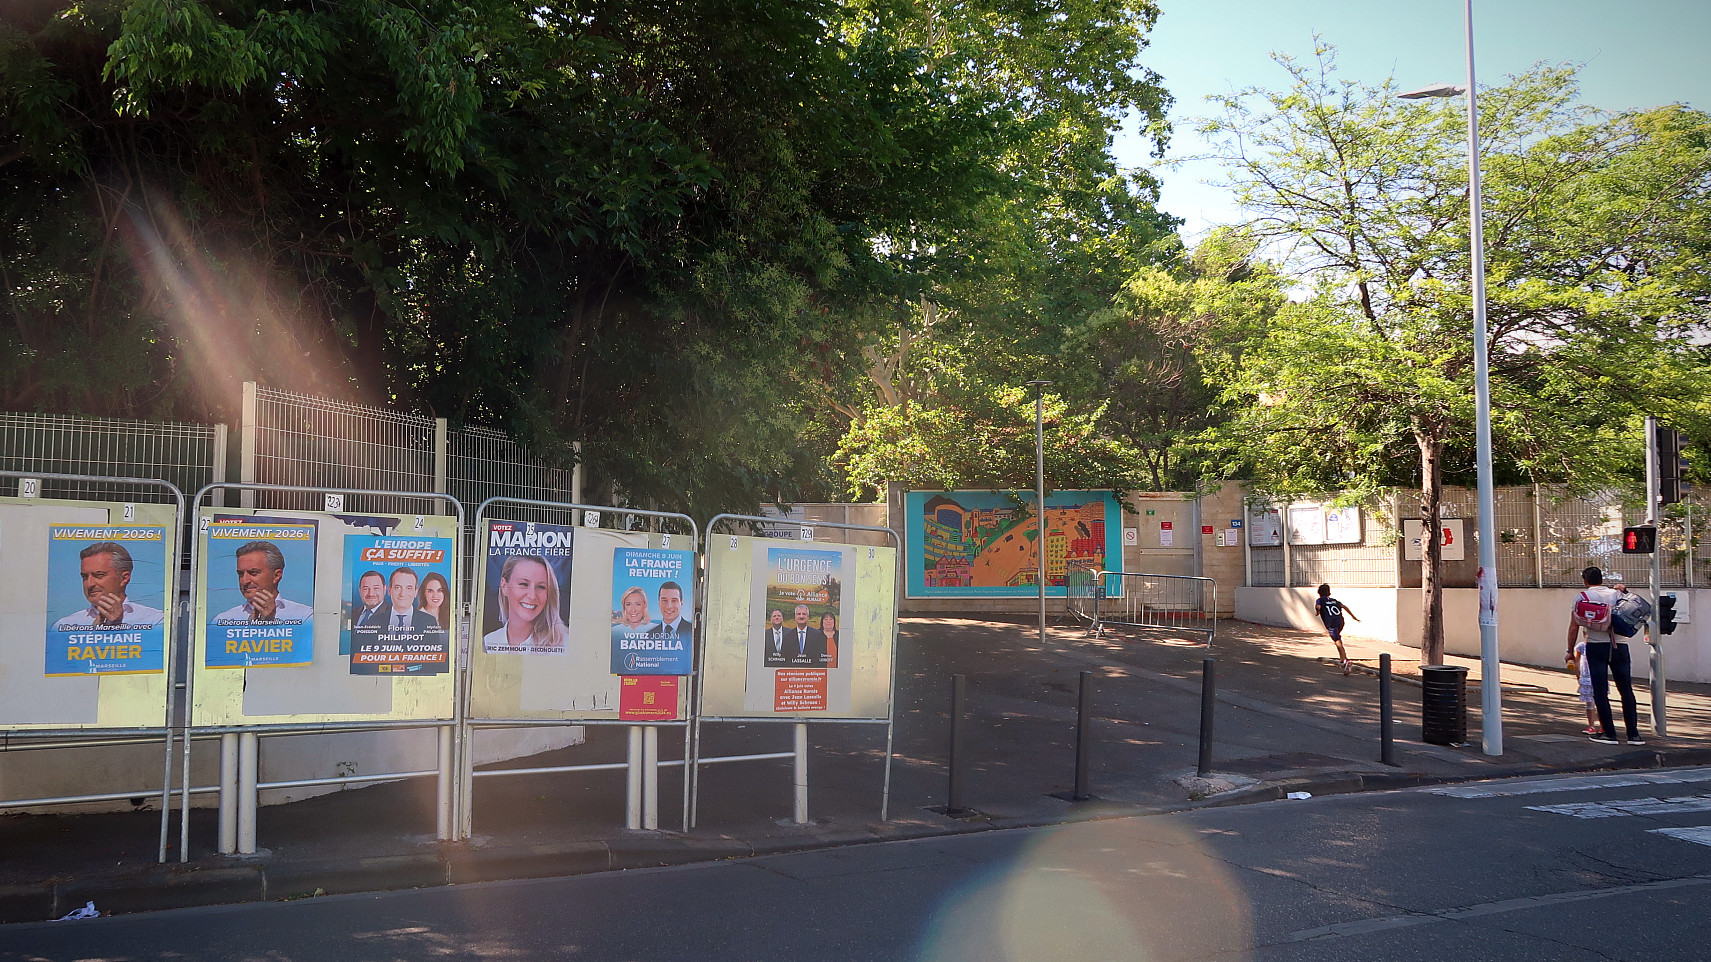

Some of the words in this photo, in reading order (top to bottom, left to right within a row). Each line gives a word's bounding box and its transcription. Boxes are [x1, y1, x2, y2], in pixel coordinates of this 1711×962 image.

[24, 482, 36, 494] 20
[124, 506, 134, 518] 21
[415, 518, 424, 529] 24
[54, 528, 120, 538] VIVEMENT
[122, 530, 154, 539] 2026
[156, 530, 162, 539] !
[212, 528, 272, 538] VIVEMENT
[274, 530, 304, 538] 2026
[490, 531, 572, 547] MARION
[662, 536, 670, 546] 27
[730, 538, 738, 549] 28
[375, 540, 432, 550] L'EUROPE
[366, 549, 385, 560] ÇA
[388, 550, 435, 560] SUFFIT
[436, 551, 443, 560] !
[490, 548, 501, 556] LA
[504, 548, 542, 556] FRANCE
[545, 546, 570, 556] FIÈRE
[626, 559, 638, 567] LA
[641, 560, 682, 569] FRANCE
[778, 558, 832, 573] L'URGENCE
[629, 569, 672, 578] REVIENT
[777, 573, 788, 583] DU
[790, 573, 806, 584] BON
[808, 574, 827, 585] SENS
[1326, 606, 1341, 616] 10
[59, 624, 94, 632] Libérons
[226, 627, 293, 638] STÉPHANE
[68, 632, 142, 644] STÉPHANE
[225, 640, 294, 654] RAVIER
[620, 640, 684, 650] BARDELLA
[67, 645, 142, 660] RAVIER
[360, 654, 386, 662] POUR
